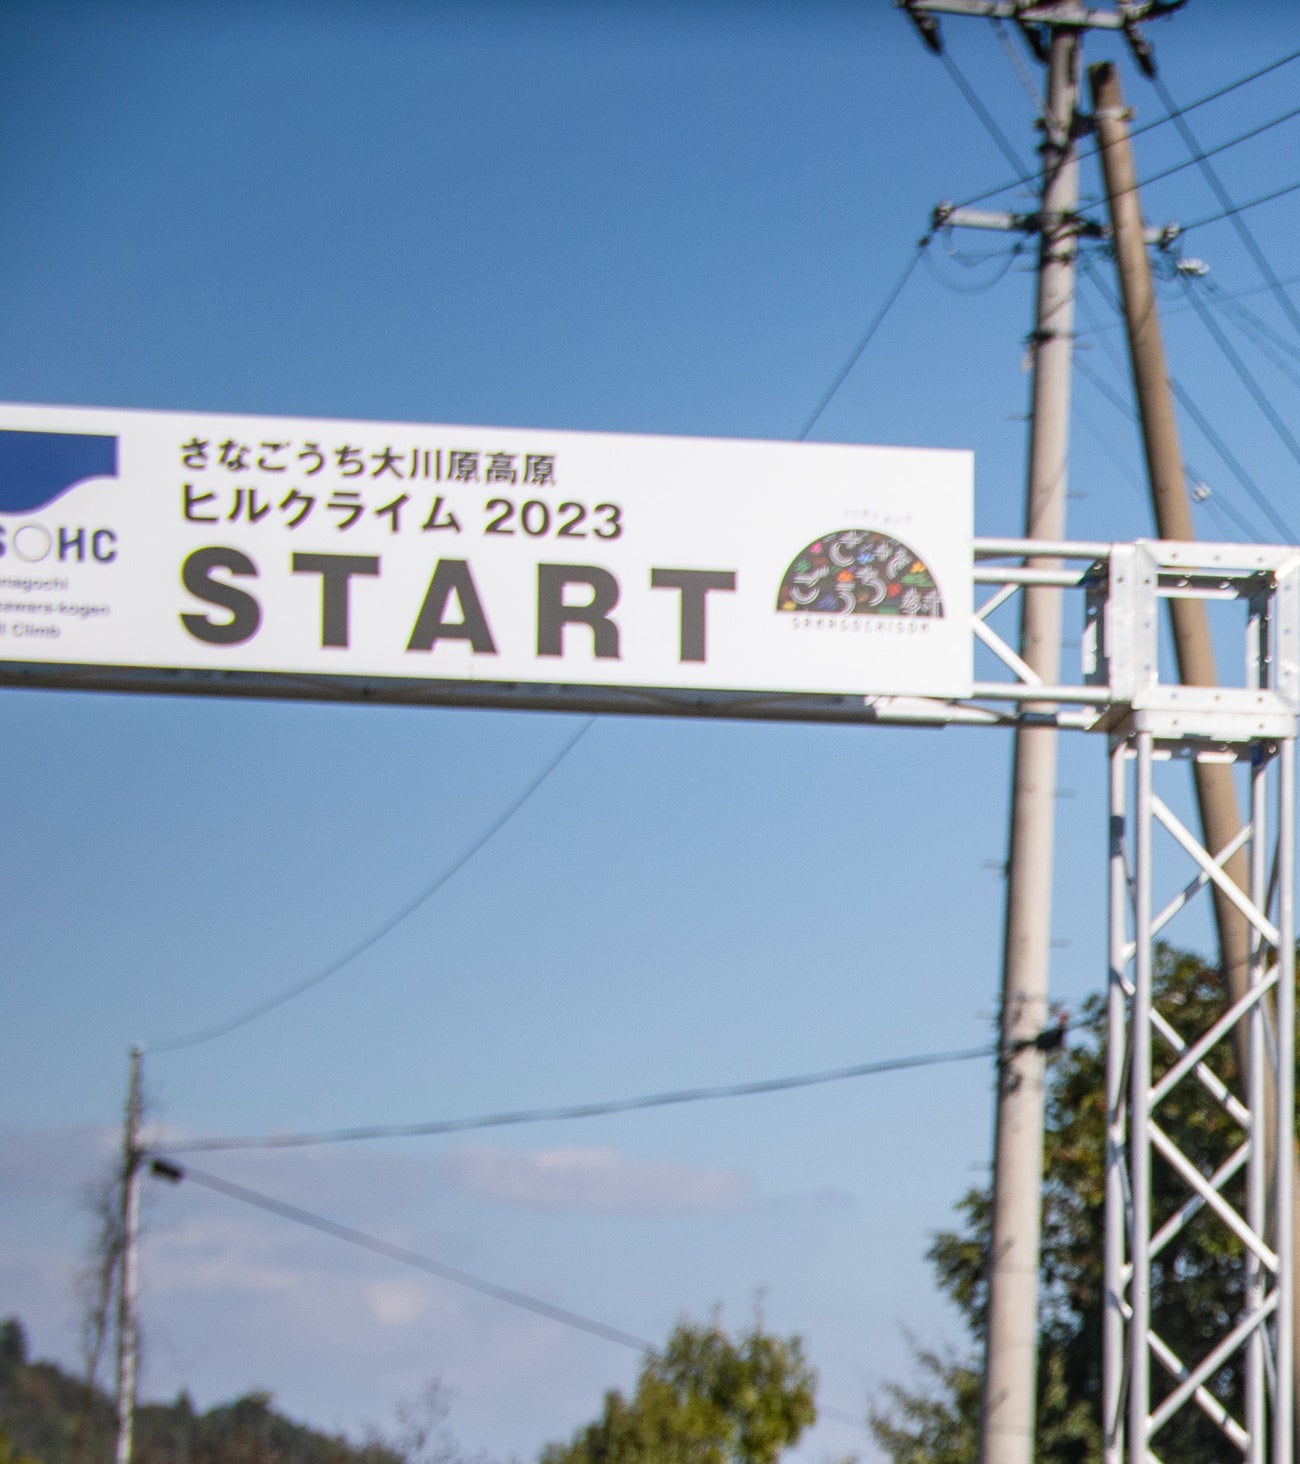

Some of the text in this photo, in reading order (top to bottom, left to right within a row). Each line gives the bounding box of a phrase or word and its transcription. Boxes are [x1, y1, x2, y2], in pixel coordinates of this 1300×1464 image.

[180, 437, 558, 487] さなごうち大川原高原
[182, 482, 624, 541] ヒルクライム 2023
[178, 545, 738, 663] START
